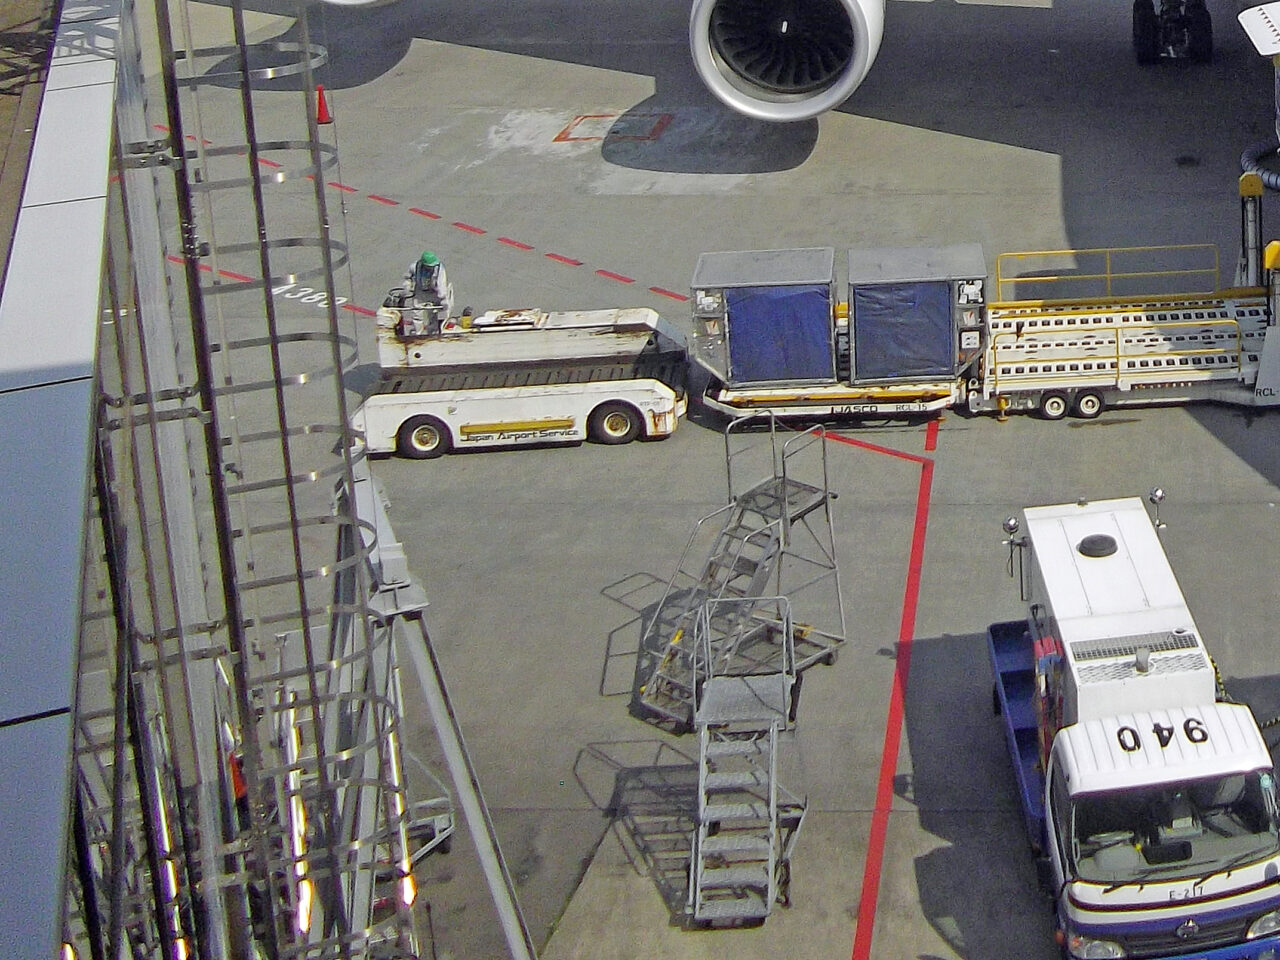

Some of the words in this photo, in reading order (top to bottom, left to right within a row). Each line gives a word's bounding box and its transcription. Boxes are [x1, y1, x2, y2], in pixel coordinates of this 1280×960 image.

[835, 405, 878, 414] JASCO
[460, 431, 494, 443] Japan
[497, 431, 537, 442] Airport
[539, 429, 579, 438] Service
[1116, 718, 1208, 752] 940
